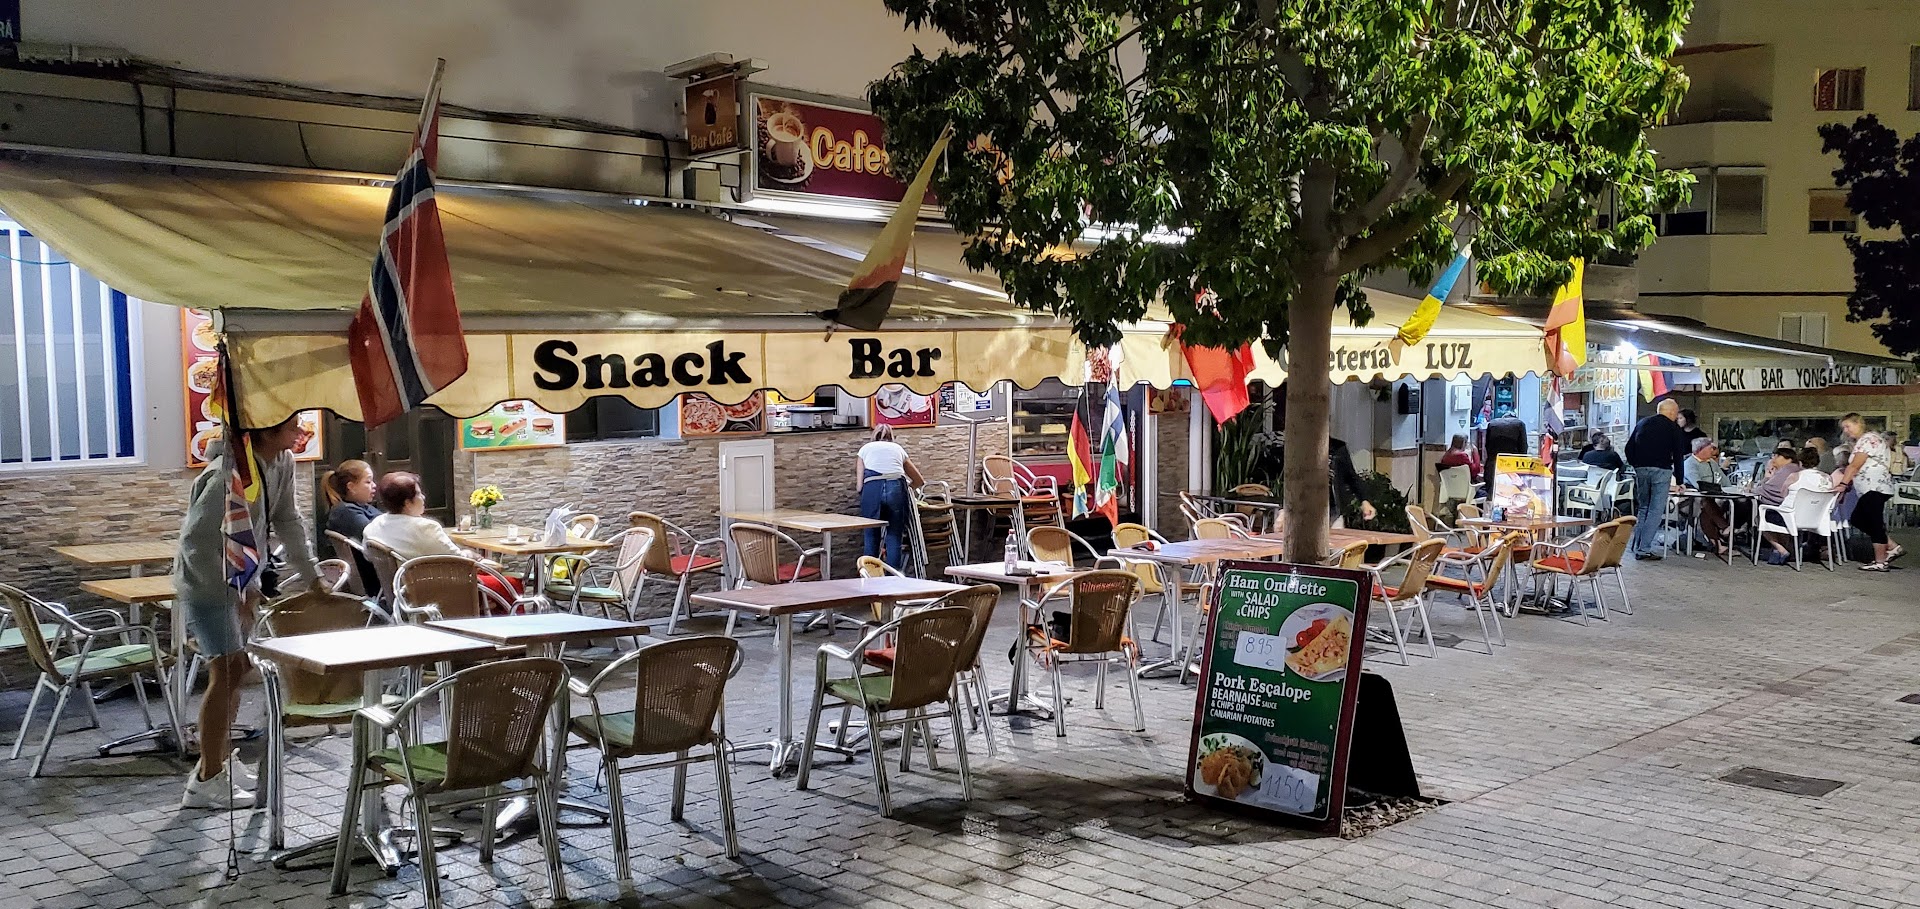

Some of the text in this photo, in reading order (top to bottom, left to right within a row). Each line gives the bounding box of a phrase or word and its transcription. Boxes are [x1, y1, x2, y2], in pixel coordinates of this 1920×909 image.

[691, 127, 733, 150] Bar Café
[533, 337, 942, 391] Snack Bar
[1425, 343, 1473, 370] LUZ
[1705, 367, 1826, 391] SNACK BAR YONG
[1229, 575, 1327, 597] Ham Omelette
[1230, 590, 1279, 607] WITH SALAD
[1214, 672, 1246, 690] Pork
[1210, 700, 1245, 712] & CHIPS OR
[1212, 687, 1278, 710] BEARNAISE SAUCE
[1210, 708, 1276, 728] CANARIAN POTATOES
